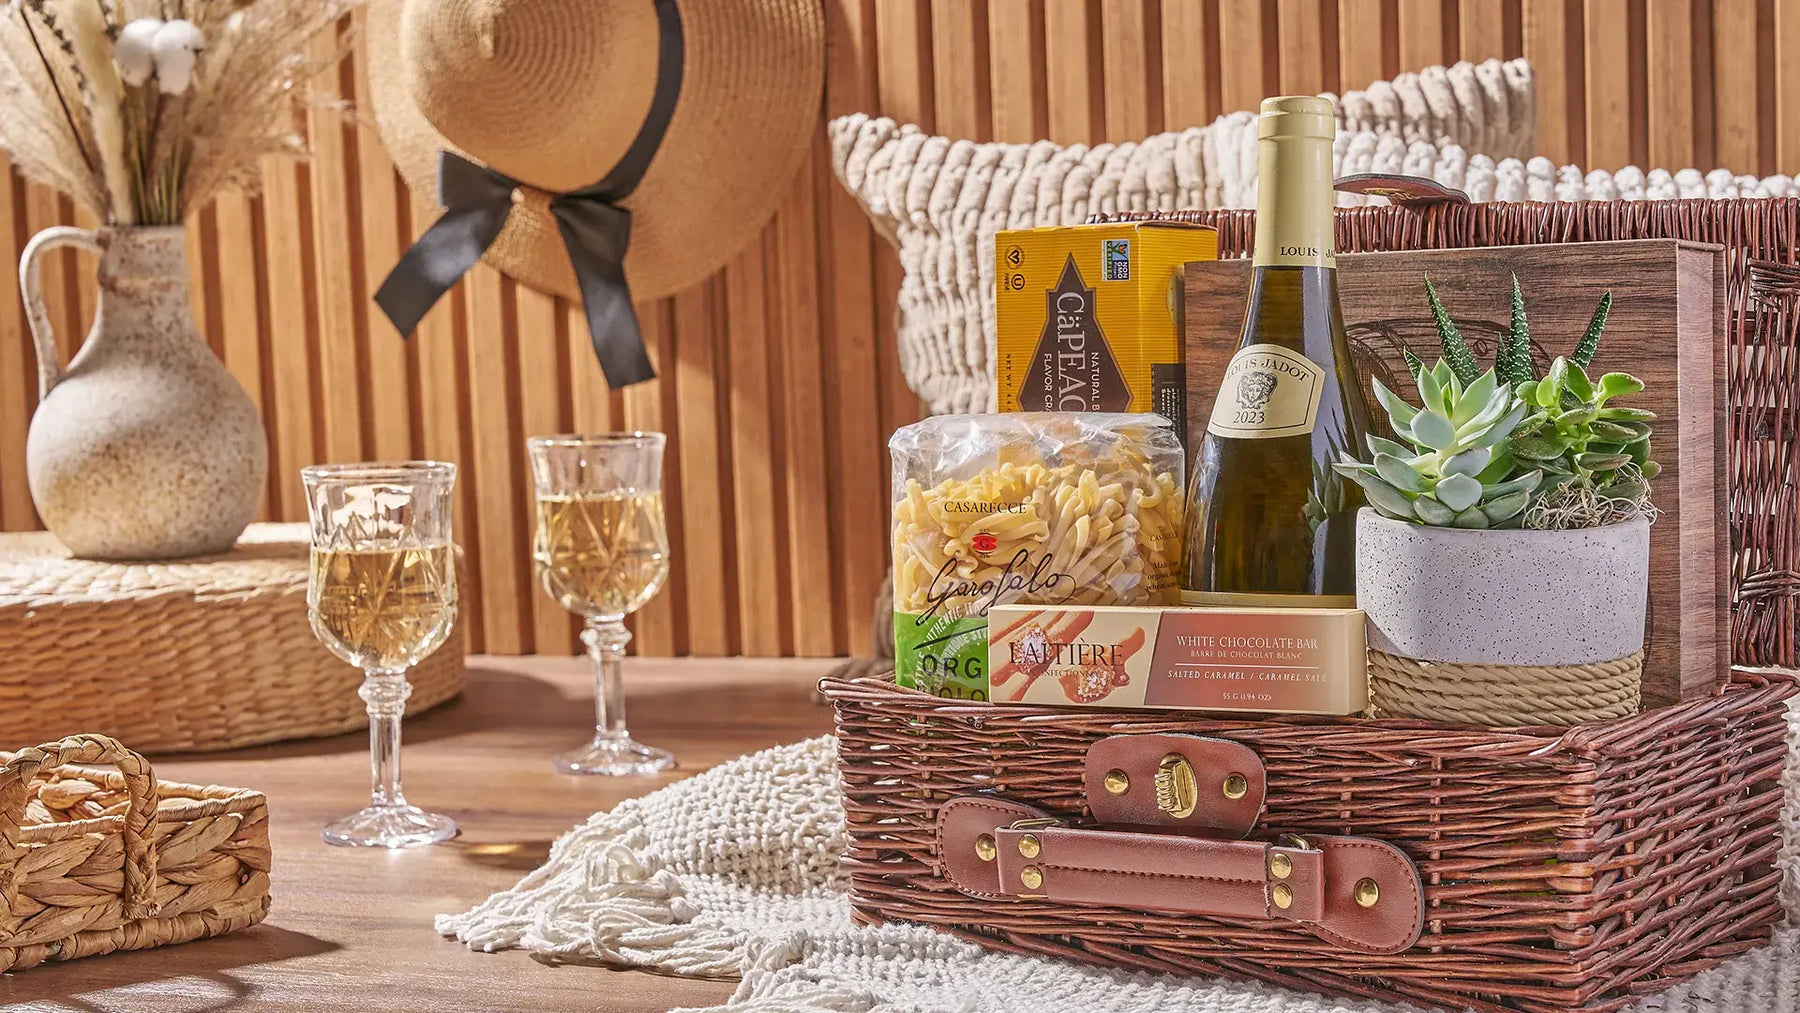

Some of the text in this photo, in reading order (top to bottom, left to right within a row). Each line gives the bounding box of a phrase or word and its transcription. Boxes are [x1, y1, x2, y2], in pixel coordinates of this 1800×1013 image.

[1280, 246, 1319, 257] LOUIS
[1044, 353, 1053, 391] FLAVOR
[1091, 352, 1100, 401] NATURAL
[1227, 358, 1309, 382] LOUIS JADOT
[1232, 411, 1265, 424] 2023
[944, 501, 1028, 515] CASARECCE
[915, 549, 1076, 627] Garofalo
[1176, 635, 1319, 649] WHITE CHOCOLATE BAR
[1009, 637, 1124, 667] LAITIÈRE
[1190, 650, 1214, 658] BARRE
[1230, 651, 1273, 659] CHOCOLAT
[1276, 652, 1304, 660] BLANC
[1167, 670, 1201, 679] SALTED
[1204, 671, 1246, 680] CARAMEL
[1258, 672, 1301, 682] CARAMEL
[1222, 692, 1231, 700] 55
